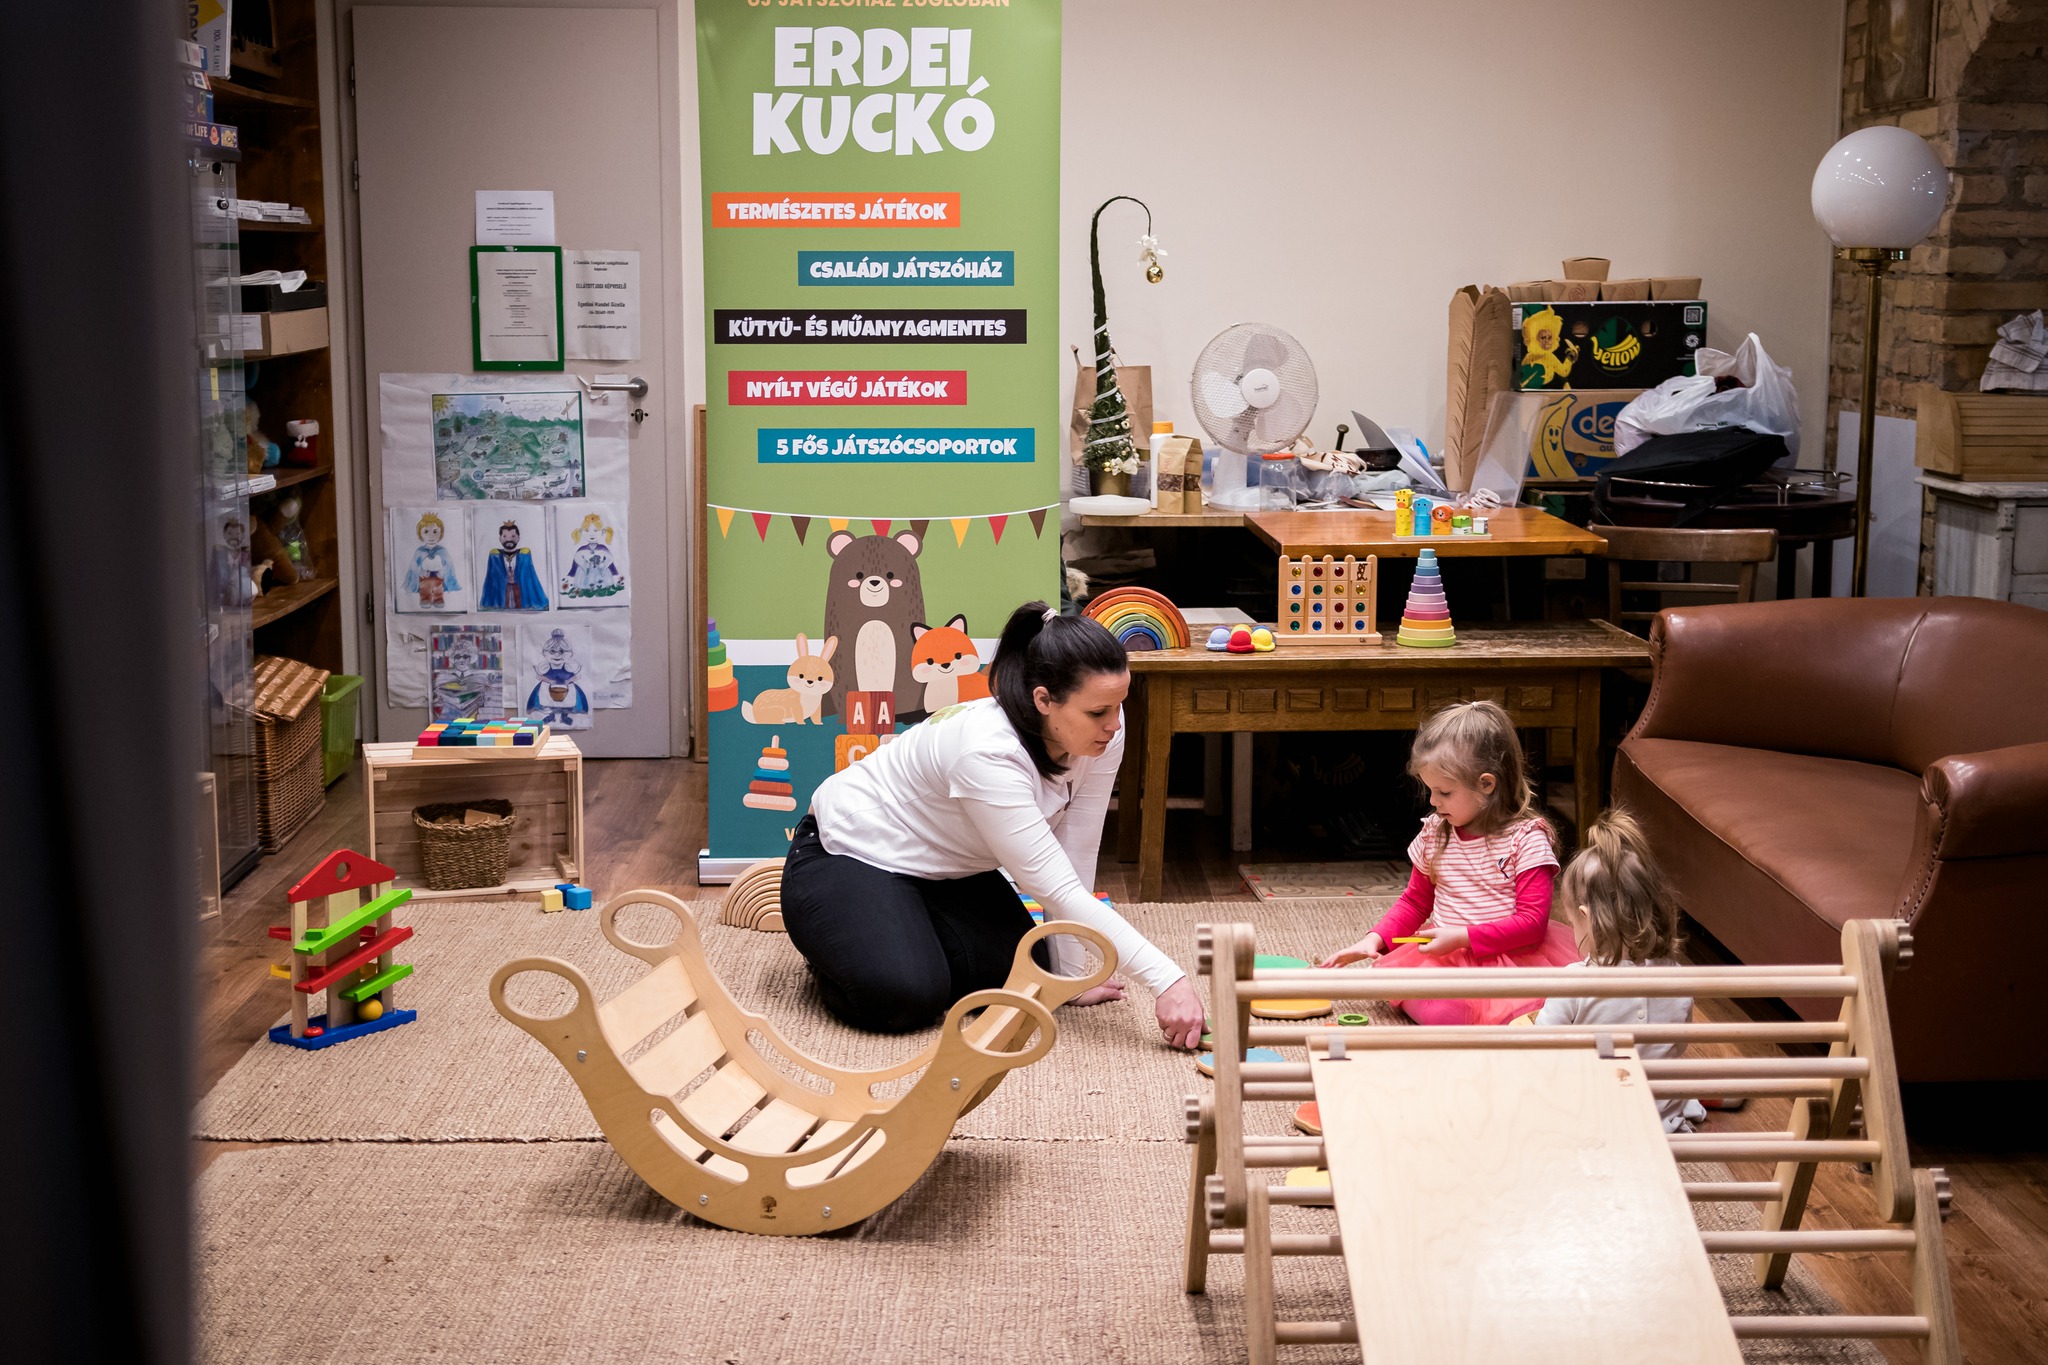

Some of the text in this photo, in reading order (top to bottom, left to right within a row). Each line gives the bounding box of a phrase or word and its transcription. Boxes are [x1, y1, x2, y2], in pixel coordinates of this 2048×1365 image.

[774, 25, 972, 87] ERDEI
[752, 75, 996, 156] KUCKÓ
[726, 197, 948, 221] TERMÉSZETES JÁTÉKOK
[809, 256, 1003, 279] CSALÁDI JÁTSZÓHÁZ
[831, 313, 1007, 337] MŰANYAGMENTES
[746, 375, 949, 399] NYÍLT VÉGŰ JÁTÉKOK
[1579, 405, 1615, 435] de
[776, 433, 1018, 456] 5 FŐS JÁTSZÓCSOPORTOK
[852, 701, 891, 725] A A
